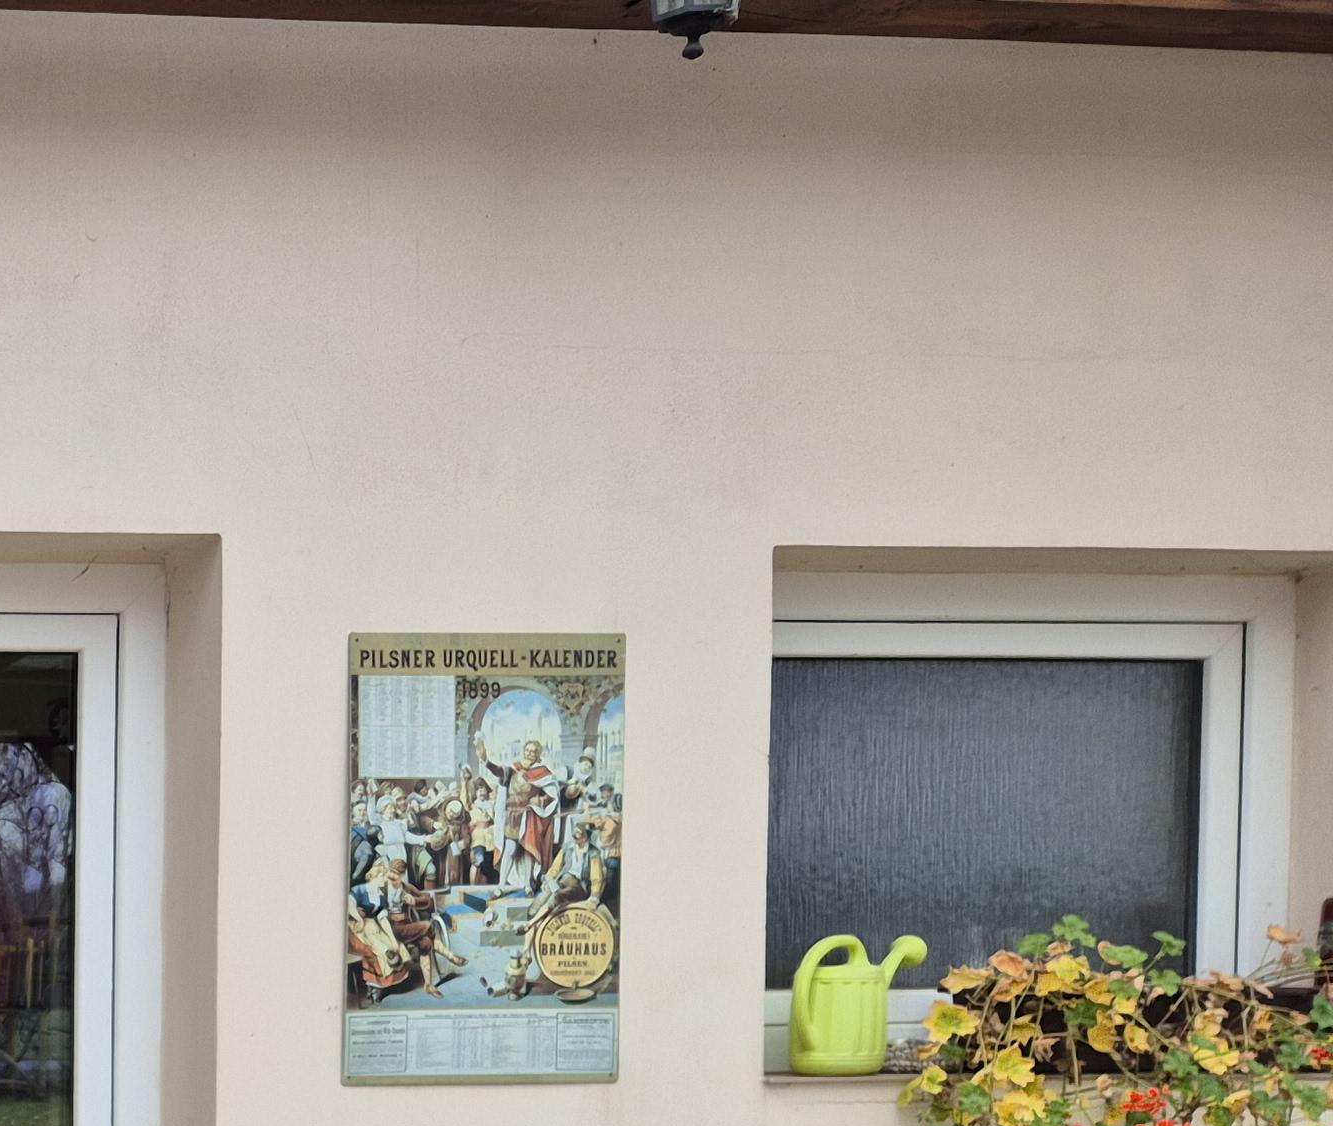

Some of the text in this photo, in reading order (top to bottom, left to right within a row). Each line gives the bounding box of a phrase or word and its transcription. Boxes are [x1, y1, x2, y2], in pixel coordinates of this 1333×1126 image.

[360, 649, 436, 669] PILSNER
[462, 681, 501, 699] 1899
[541, 941, 607, 956] BRÄUHAUS
